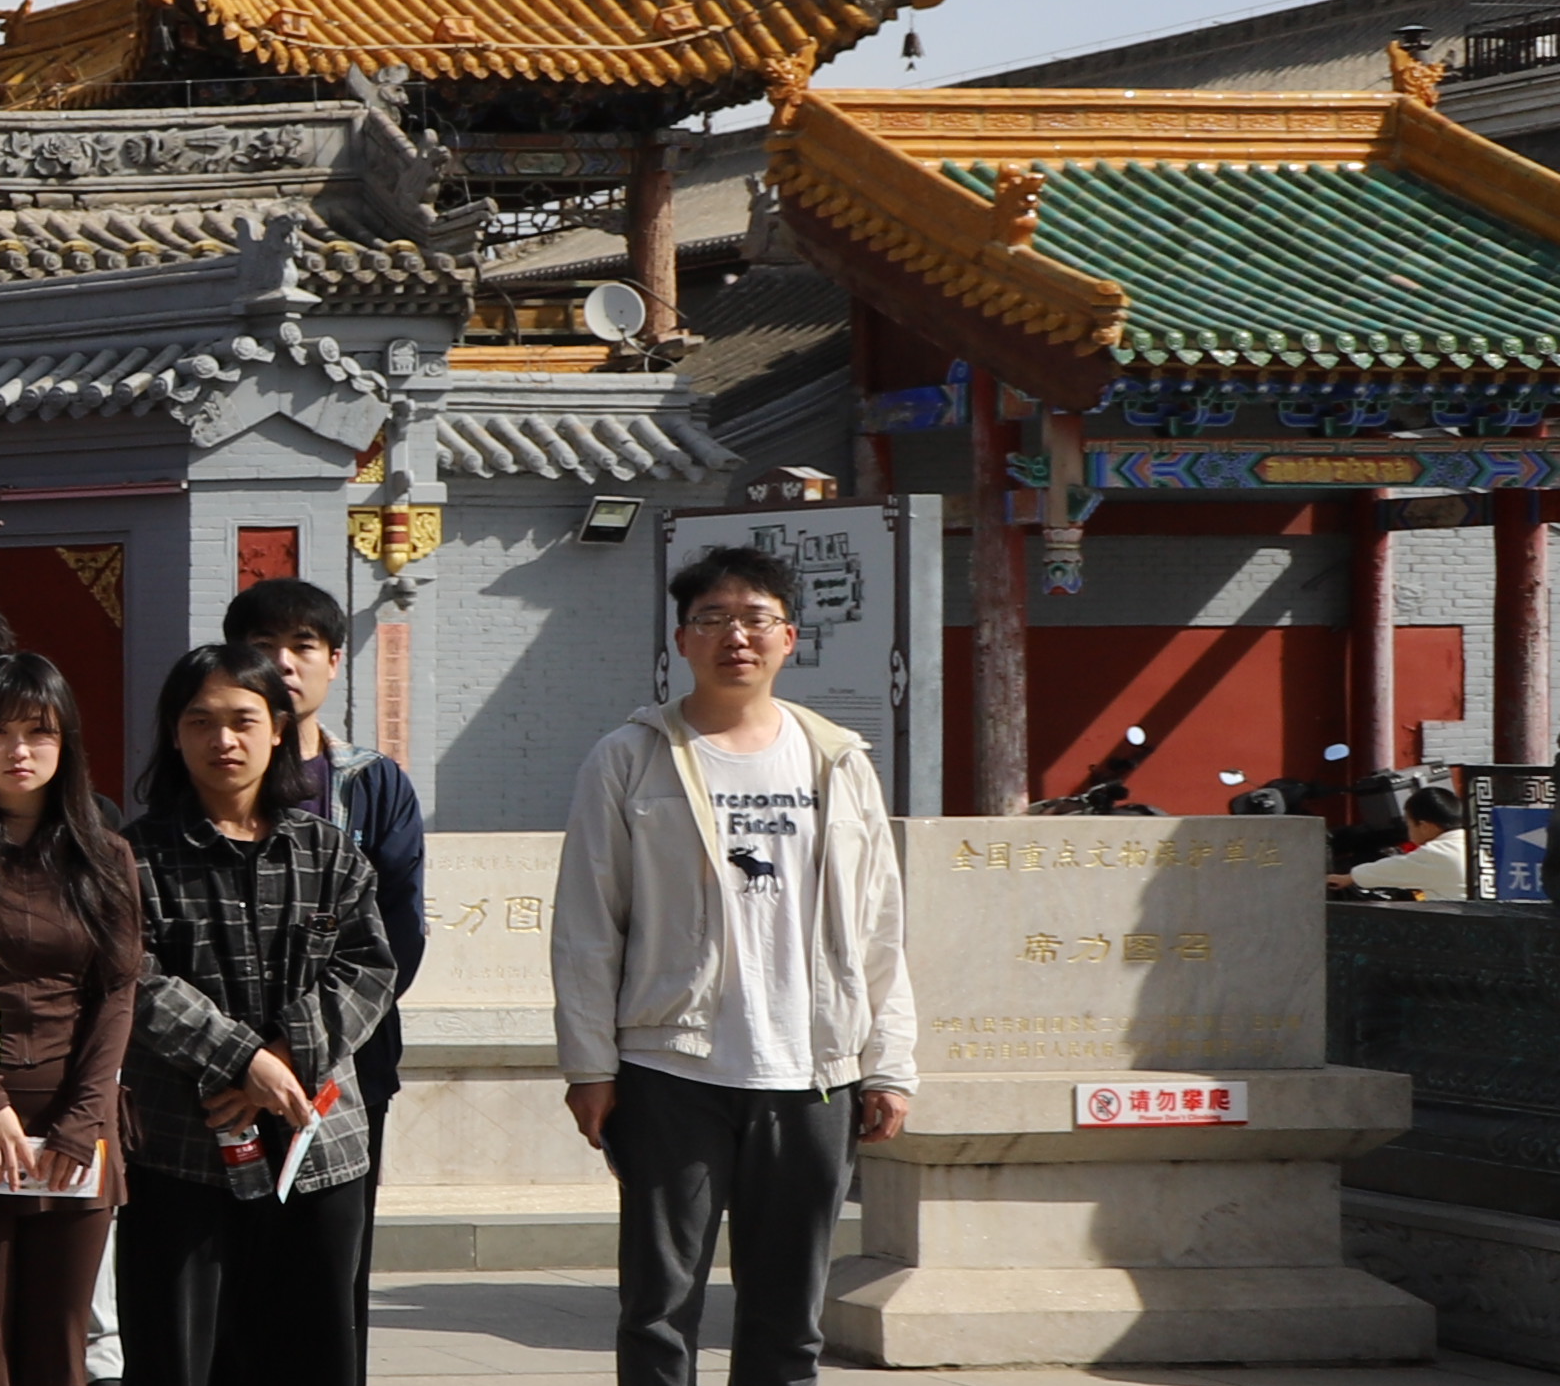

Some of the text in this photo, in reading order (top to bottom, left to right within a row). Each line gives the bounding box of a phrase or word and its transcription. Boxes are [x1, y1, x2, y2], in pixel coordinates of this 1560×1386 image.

[710, 787, 820, 810] rcrombi
[728, 813, 796, 835] Fitch
[951, 838, 1284, 871] 全国重点文物保护单位
[424, 896, 555, 937] 力图
[1017, 931, 1213, 964] 席力图召
[1129, 1089, 1231, 1112] 请勿攀爬
